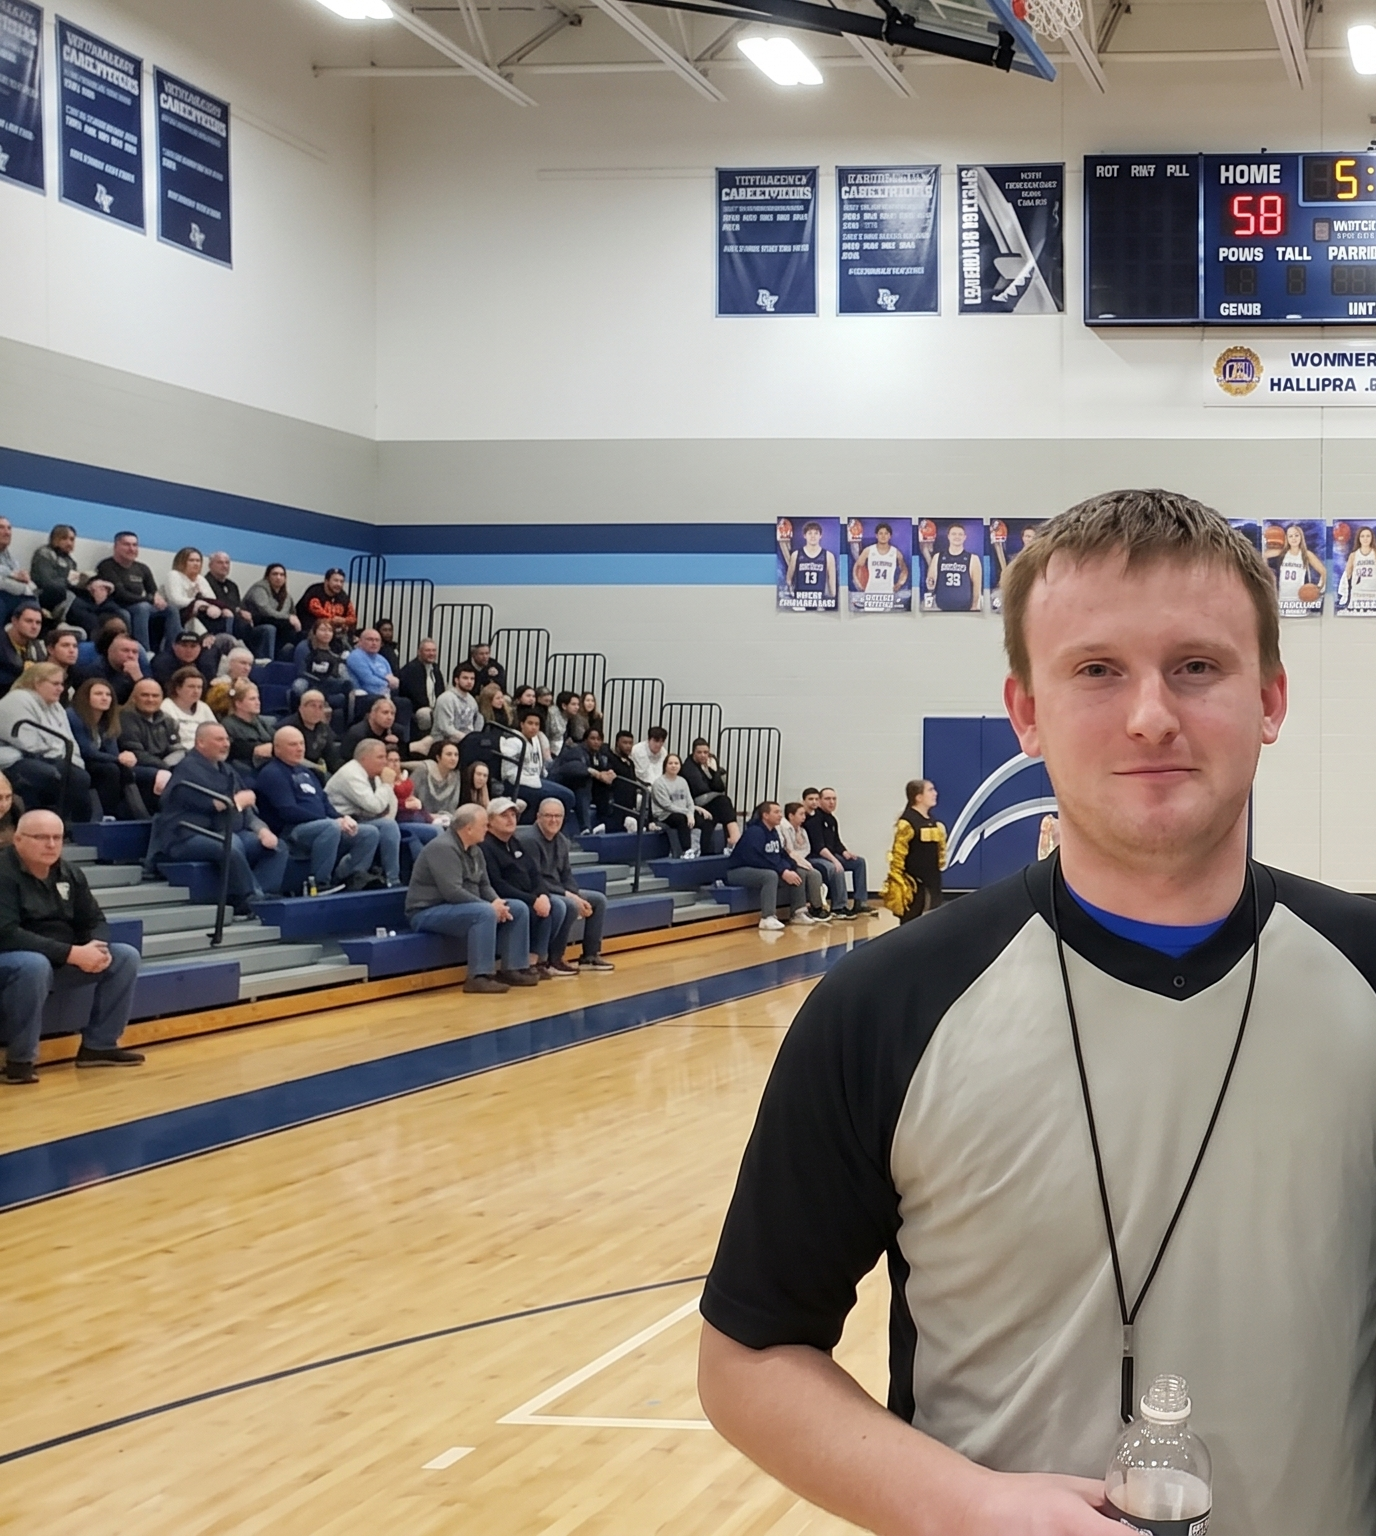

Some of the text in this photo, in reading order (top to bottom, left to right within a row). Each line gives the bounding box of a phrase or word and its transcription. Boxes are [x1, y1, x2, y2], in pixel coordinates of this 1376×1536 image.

[1096, 165, 1119, 177] ROT
[1220, 164, 1281, 185] HOME
[1233, 196, 1281, 235] 58
[1218, 247, 1264, 261] POWS
[1276, 247, 1312, 260] TALL
[1270, 378, 1356, 391] HALLIPRA
[805, 572, 817, 584] 13
[875, 569, 887, 580] 24
